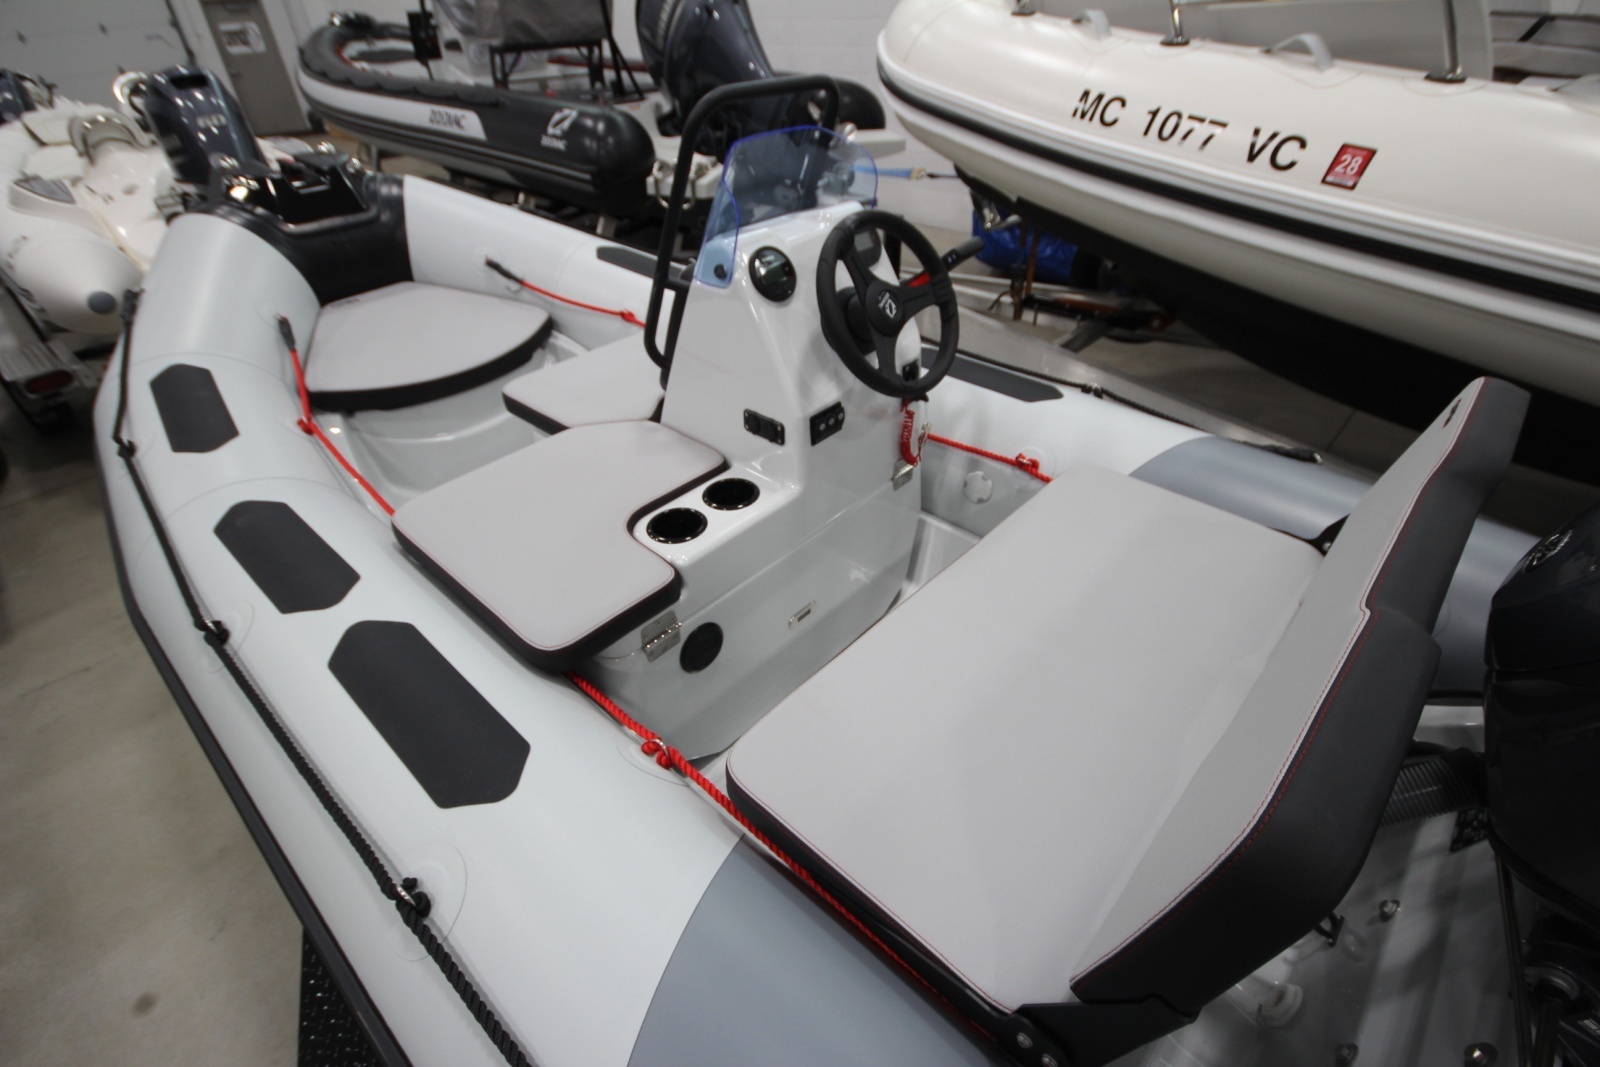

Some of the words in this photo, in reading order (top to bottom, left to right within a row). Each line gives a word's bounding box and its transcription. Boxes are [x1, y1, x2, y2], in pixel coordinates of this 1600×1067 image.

[1072, 89, 1127, 127] MC
[1143, 106, 1229, 151] 1077
[1247, 127, 1307, 171] VC
[1334, 154, 1363, 175] 28
